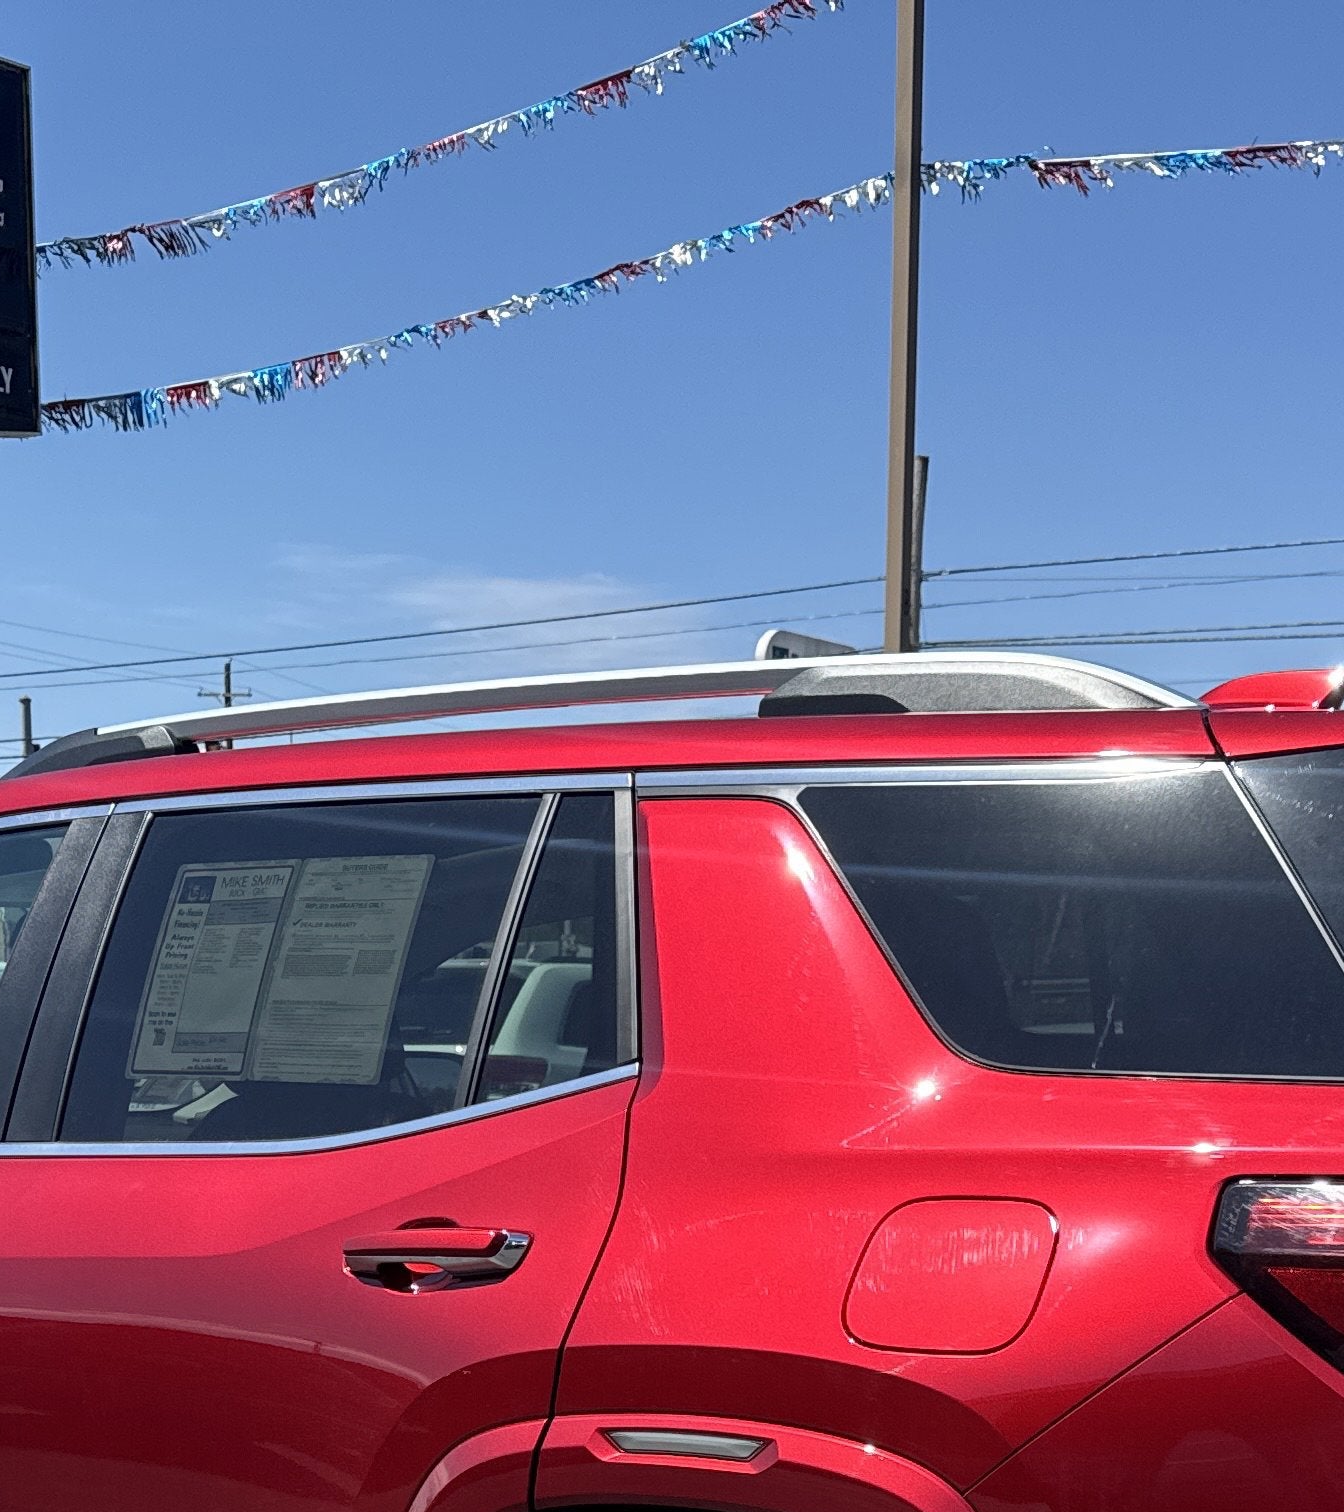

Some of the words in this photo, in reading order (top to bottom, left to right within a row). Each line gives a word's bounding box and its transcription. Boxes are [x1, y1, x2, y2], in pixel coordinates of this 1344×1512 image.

[220, 875, 248, 889] MIKE
[251, 873, 286, 887] SMITH
[324, 921, 358, 929] WARRANTY
